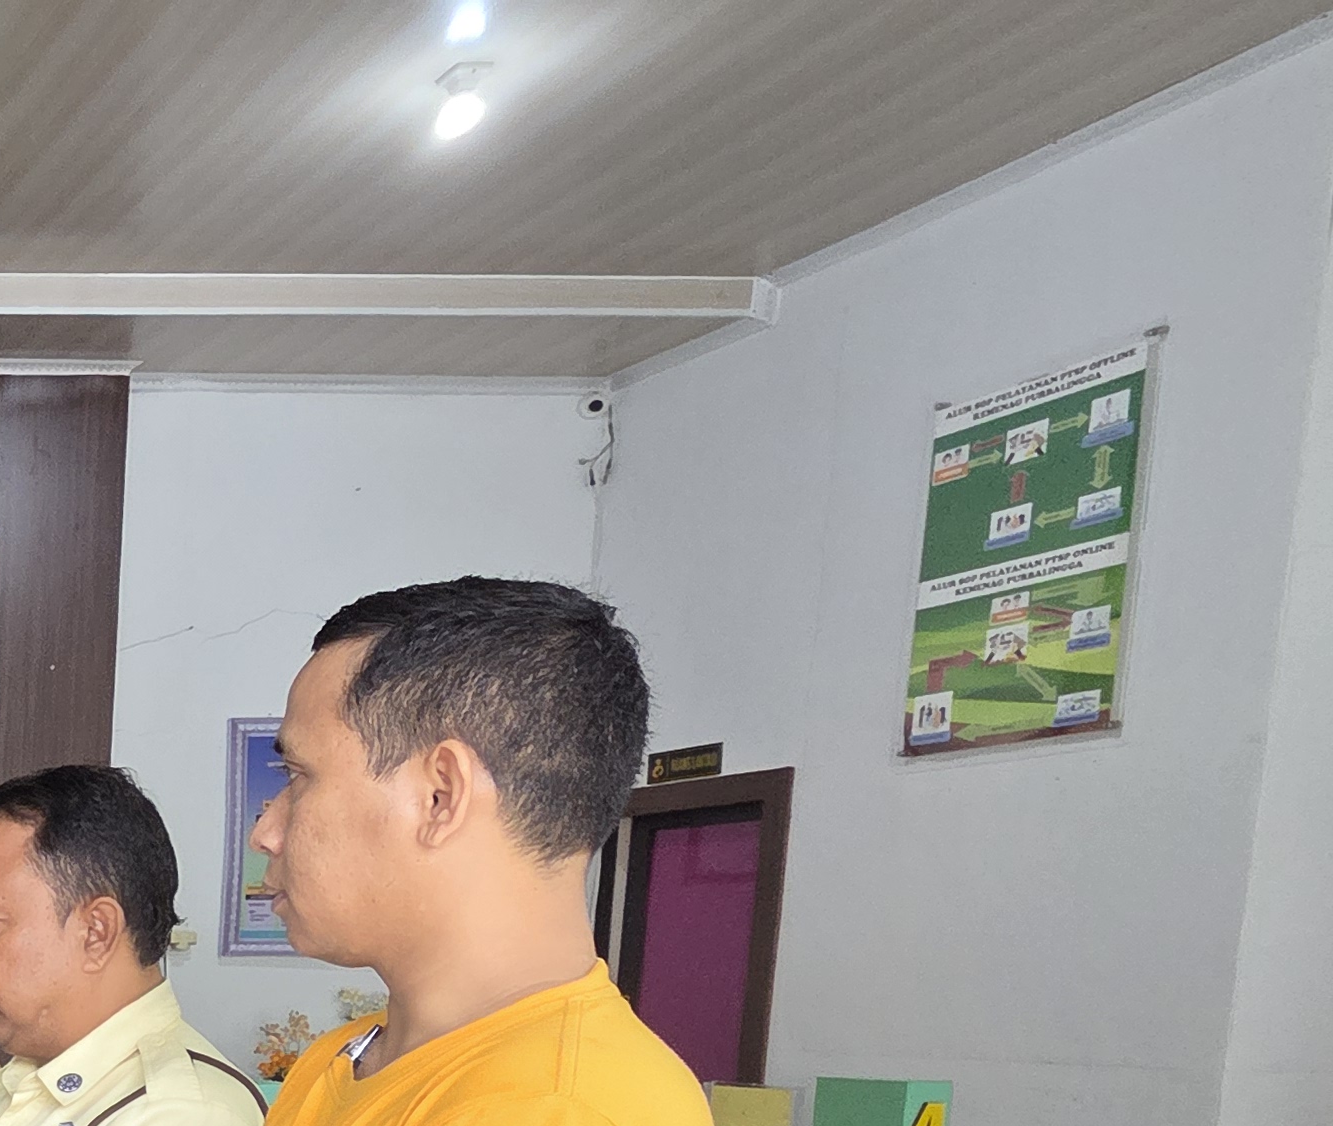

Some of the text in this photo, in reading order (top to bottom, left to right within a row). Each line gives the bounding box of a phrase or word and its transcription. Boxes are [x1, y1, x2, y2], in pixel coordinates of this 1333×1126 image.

[1089, 348, 1137, 371] OFFLINE
[980, 559, 1042, 581] PELAYANAN
[1045, 553, 1071, 565] PTSP
[1073, 541, 1115, 559] ONLINE
